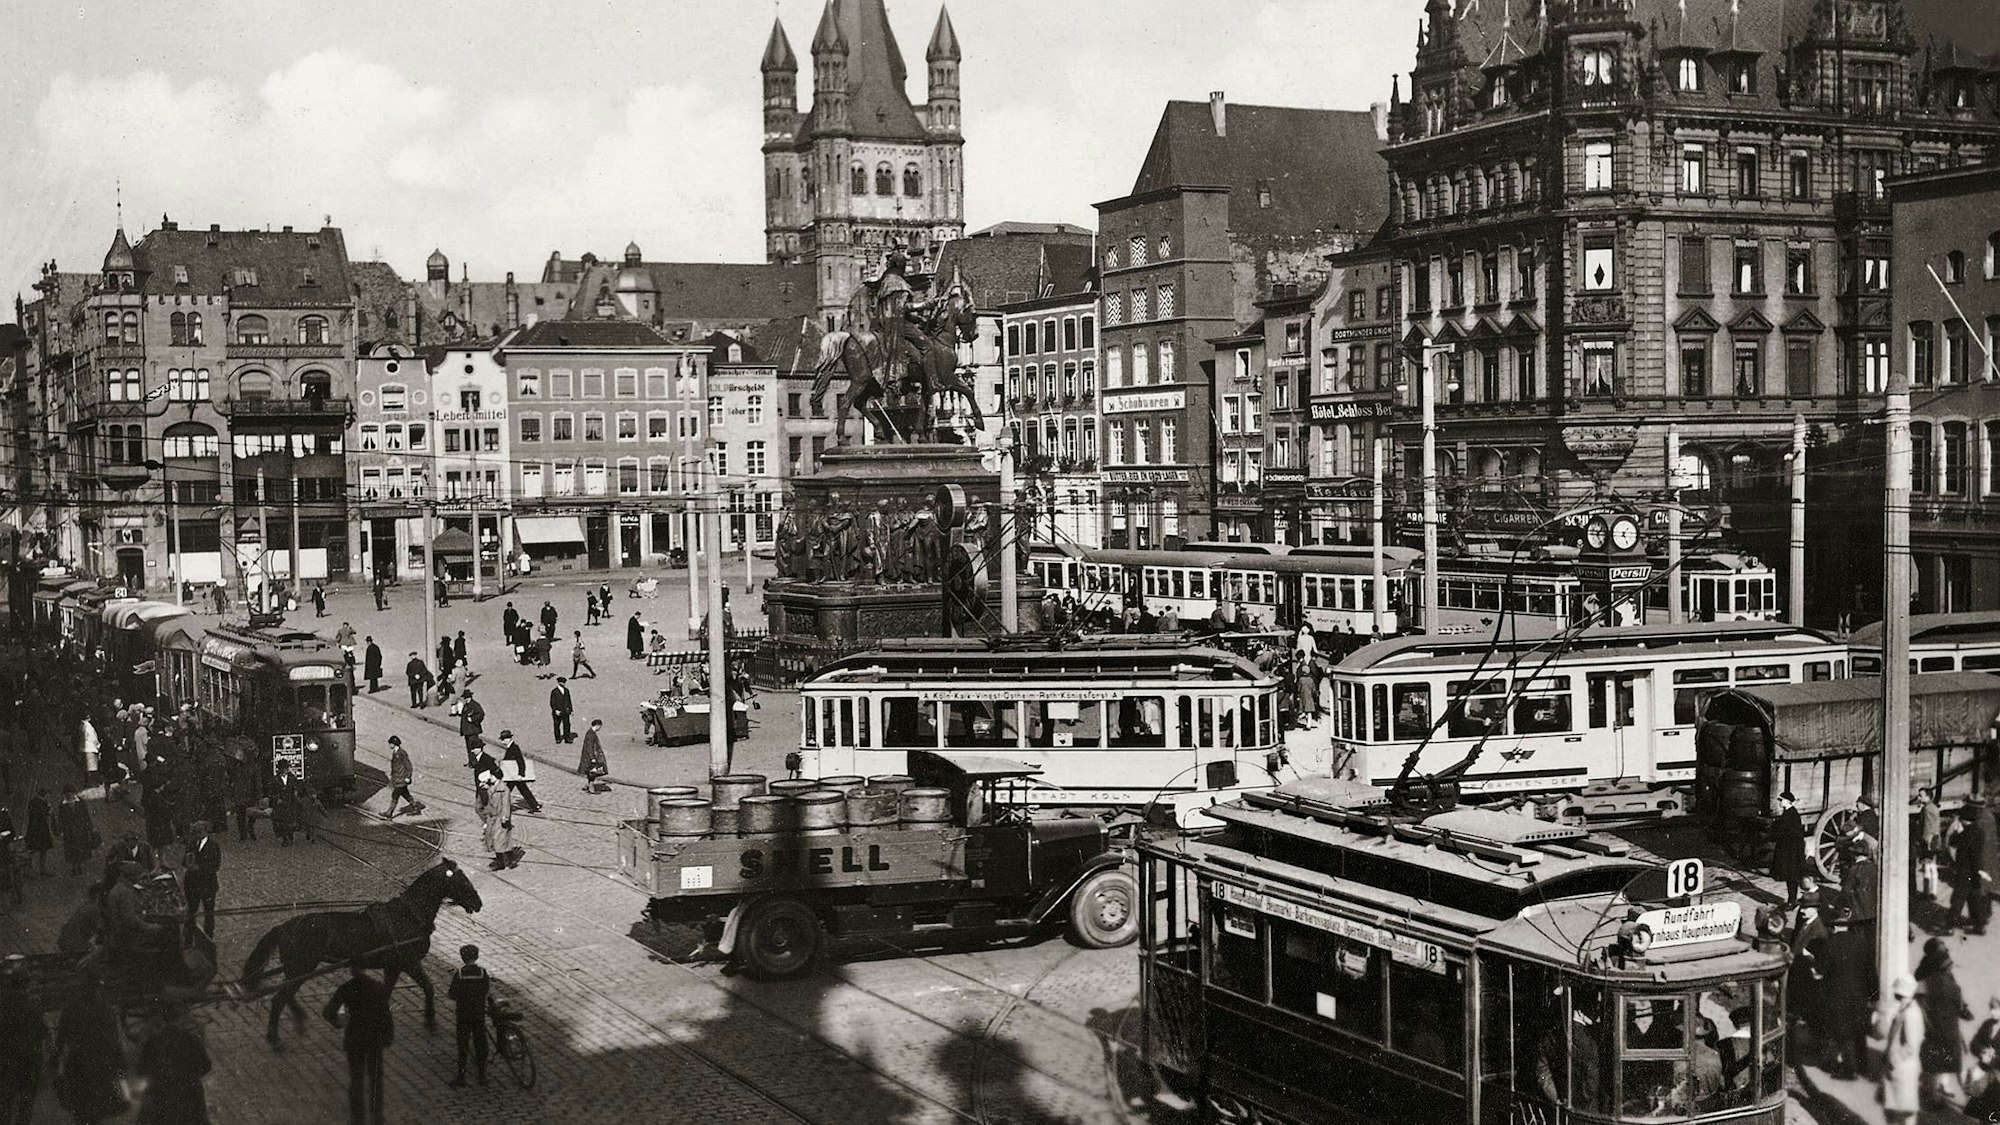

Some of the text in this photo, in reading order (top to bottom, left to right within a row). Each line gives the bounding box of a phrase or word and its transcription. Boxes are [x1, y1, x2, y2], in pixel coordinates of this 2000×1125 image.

[1334, 326, 1392, 339] DORTMUNDER UNION
[1117, 395, 1169, 411] Schuhwaren
[1338, 402, 1374, 419] Schloss
[434, 408, 507, 422] Lebenmittel
[1406, 512, 1448, 525] DRORIE
[1493, 512, 1540, 525] CIGARREN
[1612, 567, 1647, 579] Persil
[1551, 777, 1578, 786] DER
[1672, 861, 1699, 894] 18
[1214, 882, 1226, 900] 18
[1663, 907, 1715, 925] Rundfahrt
[1425, 943, 1438, 964] 18
